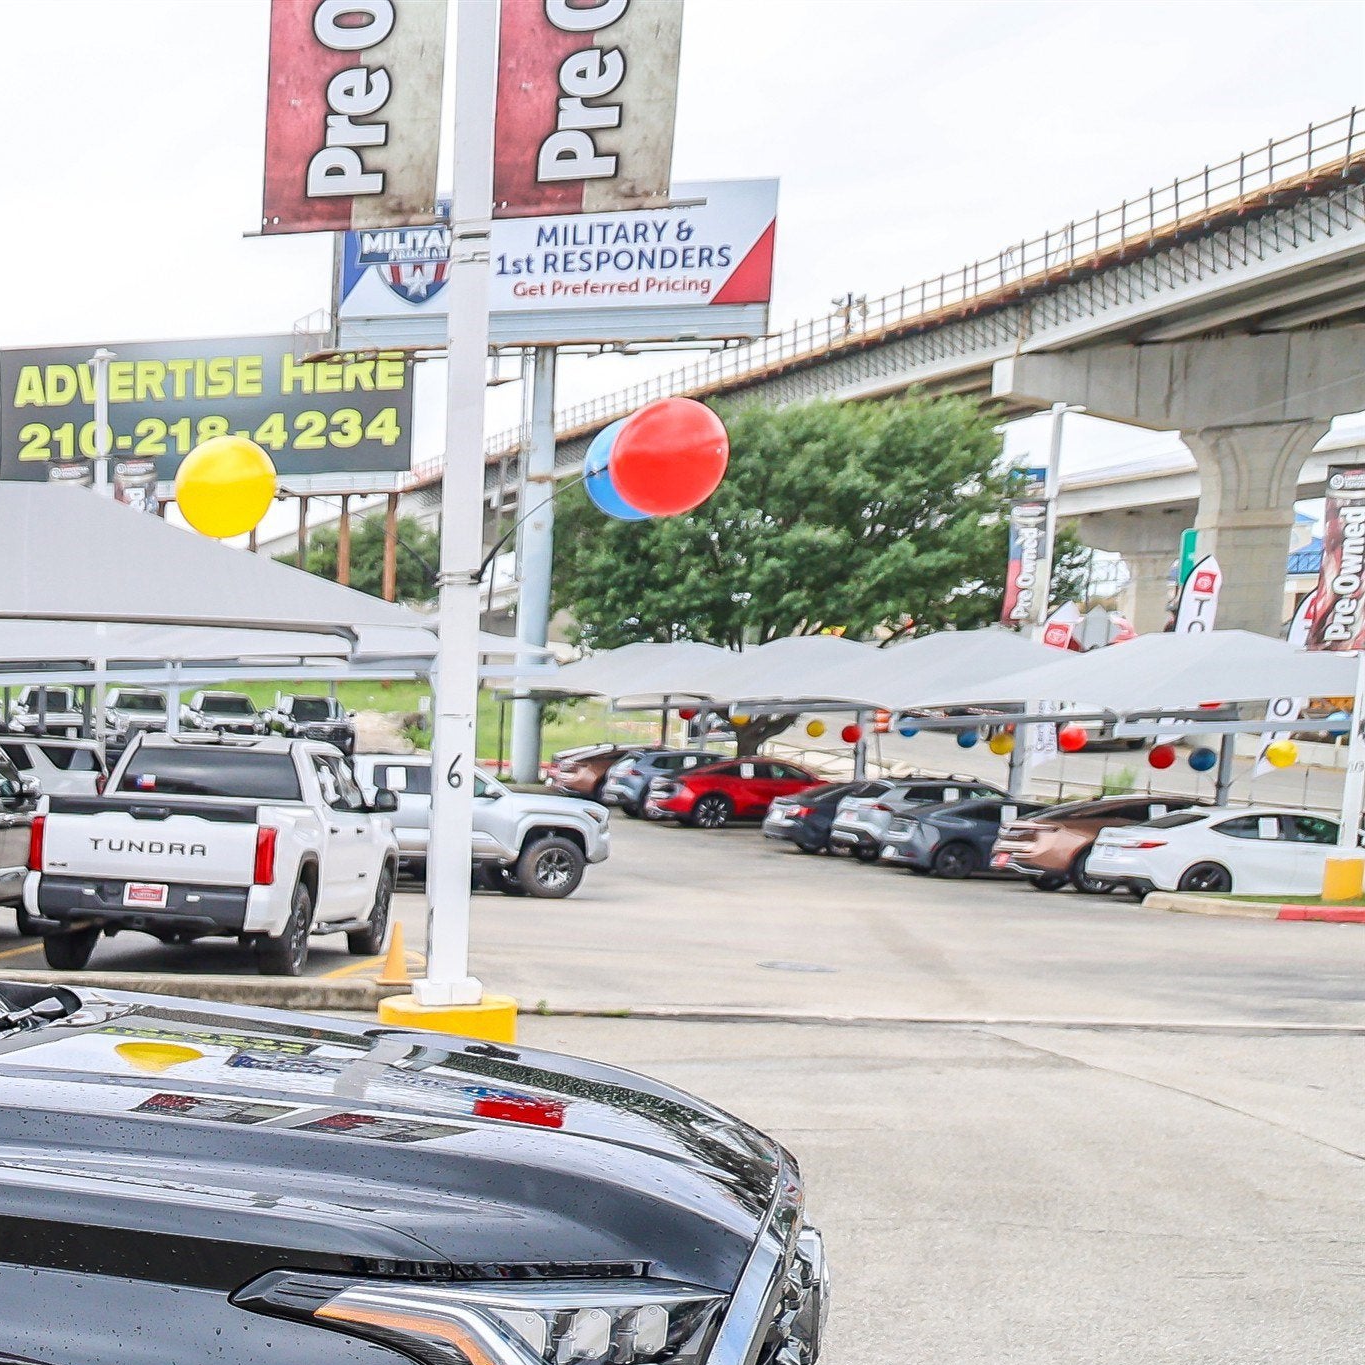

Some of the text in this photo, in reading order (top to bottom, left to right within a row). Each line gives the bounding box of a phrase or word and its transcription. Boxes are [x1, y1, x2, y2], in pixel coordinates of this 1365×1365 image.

[307, 66, 392, 198] Pre
[537, 47, 626, 183] Pre
[537, 219, 695, 248] MILITARY &
[496, 245, 732, 276] 1st RESPONDERS
[513, 275, 712, 299] Get Preferred Pricing
[13, 350, 407, 408] ADVERTISE HERE
[16, 406, 402, 462] 210-218-4234
[1332, 505, 1365, 595] Owned
[1323, 596, 1357, 641] Pre
[447, 752, 463, 788] 6
[89, 837, 207, 857] TUNDRA
